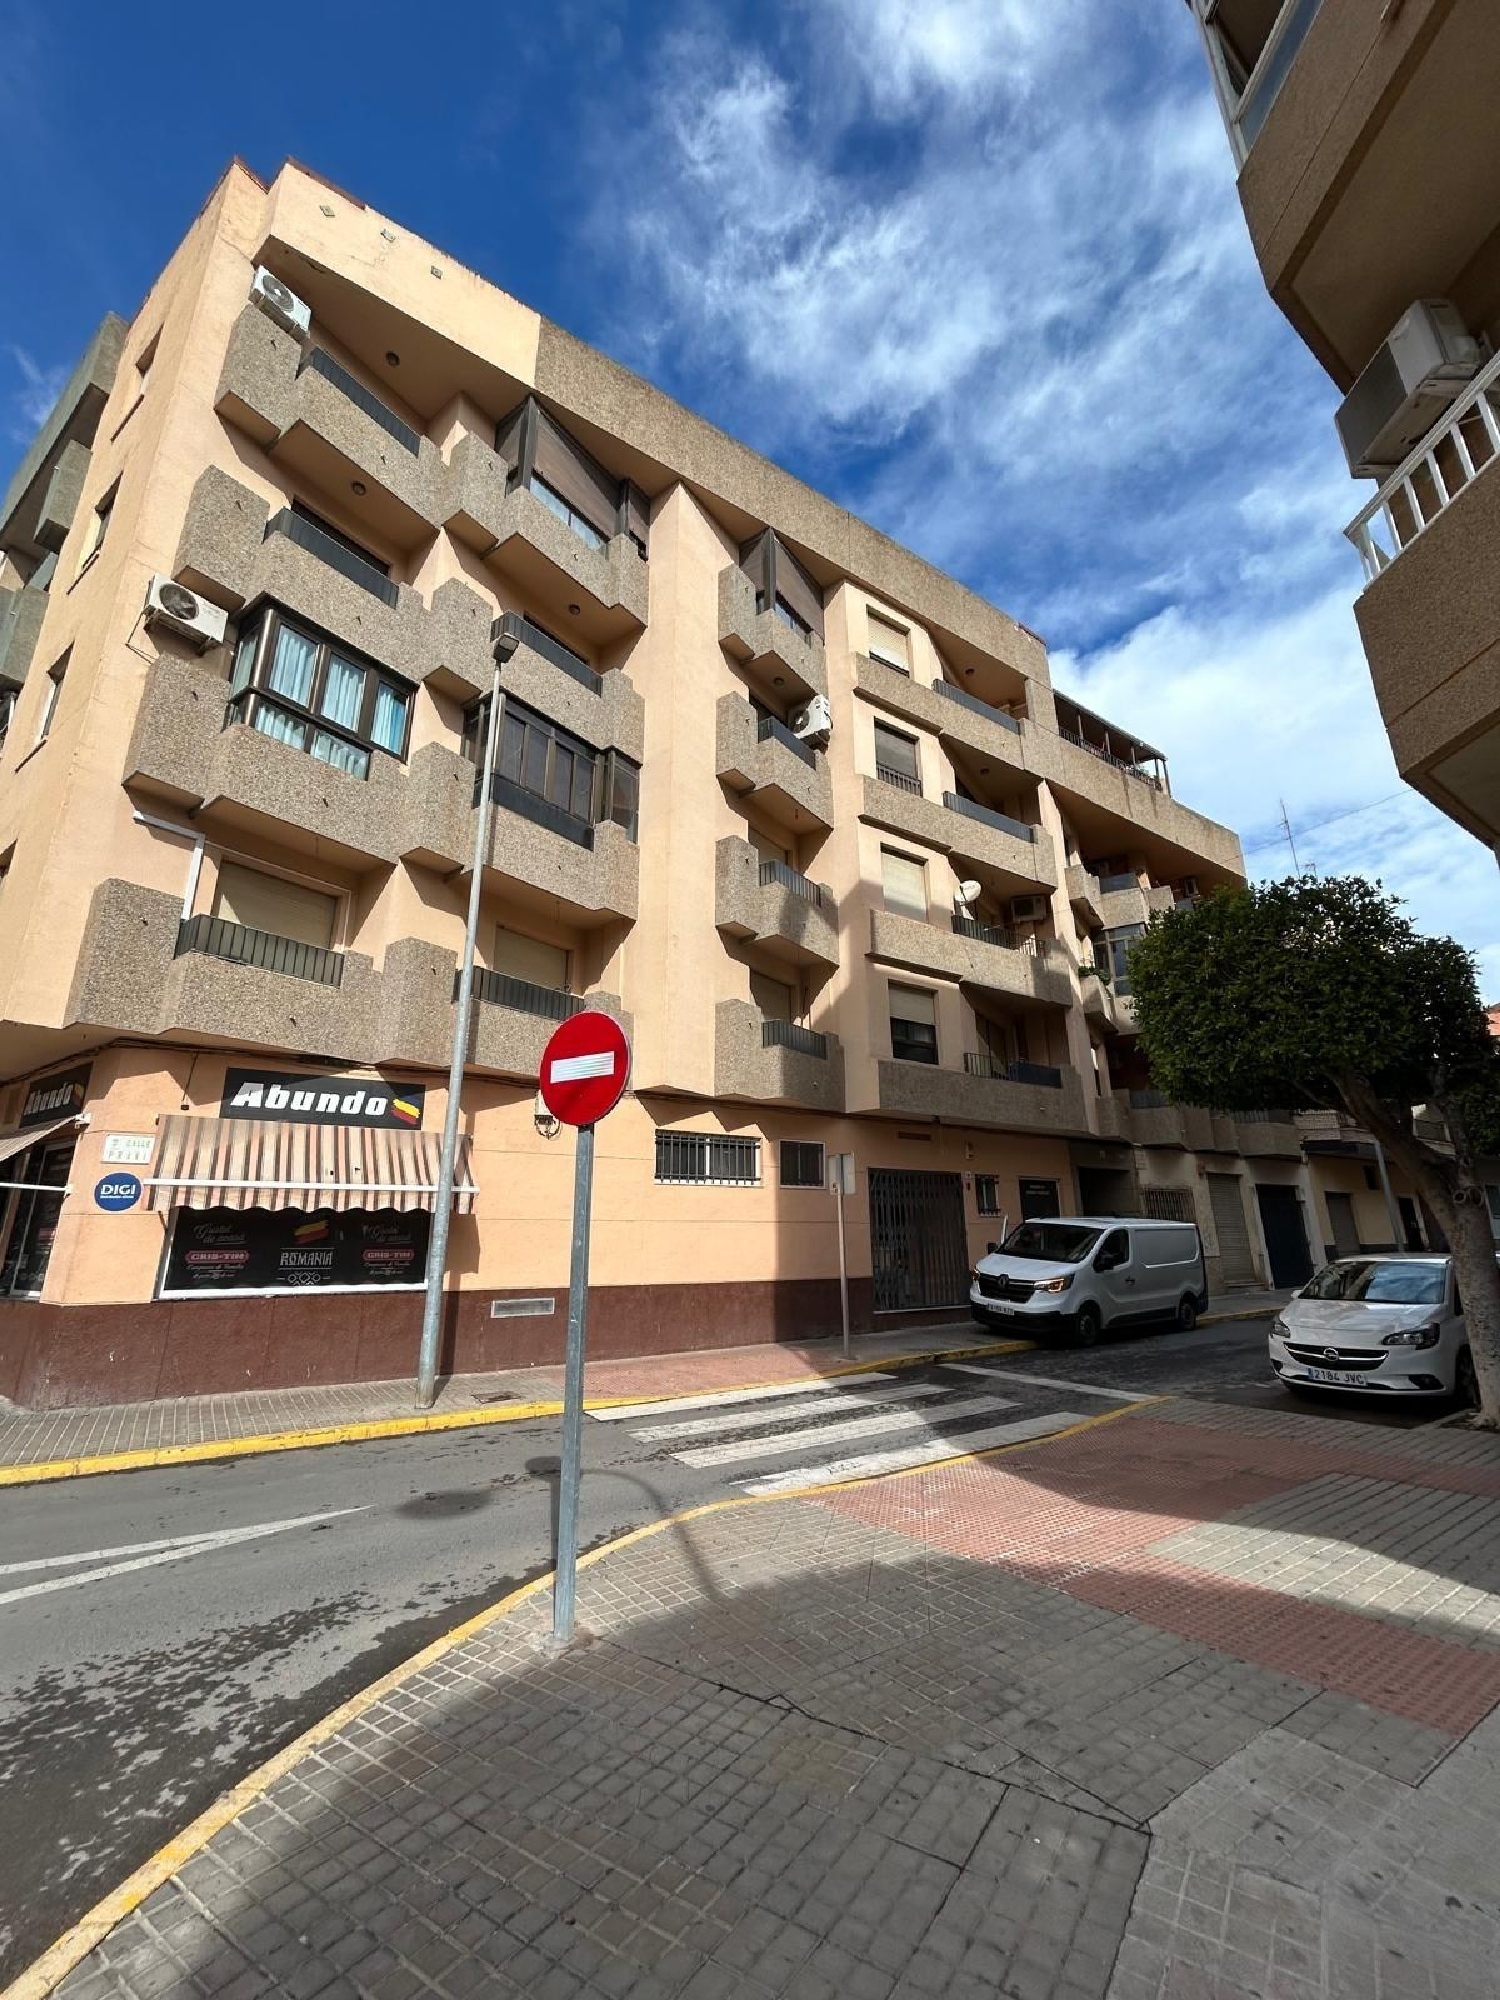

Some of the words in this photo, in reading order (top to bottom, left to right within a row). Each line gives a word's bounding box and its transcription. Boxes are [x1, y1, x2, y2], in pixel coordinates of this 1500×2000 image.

[24, 1083, 74, 1115] Abundo
[230, 1082, 388, 1116] Abundo
[100, 1184, 136, 1195] DIGI
[280, 1252, 333, 1266] ROMANIA
